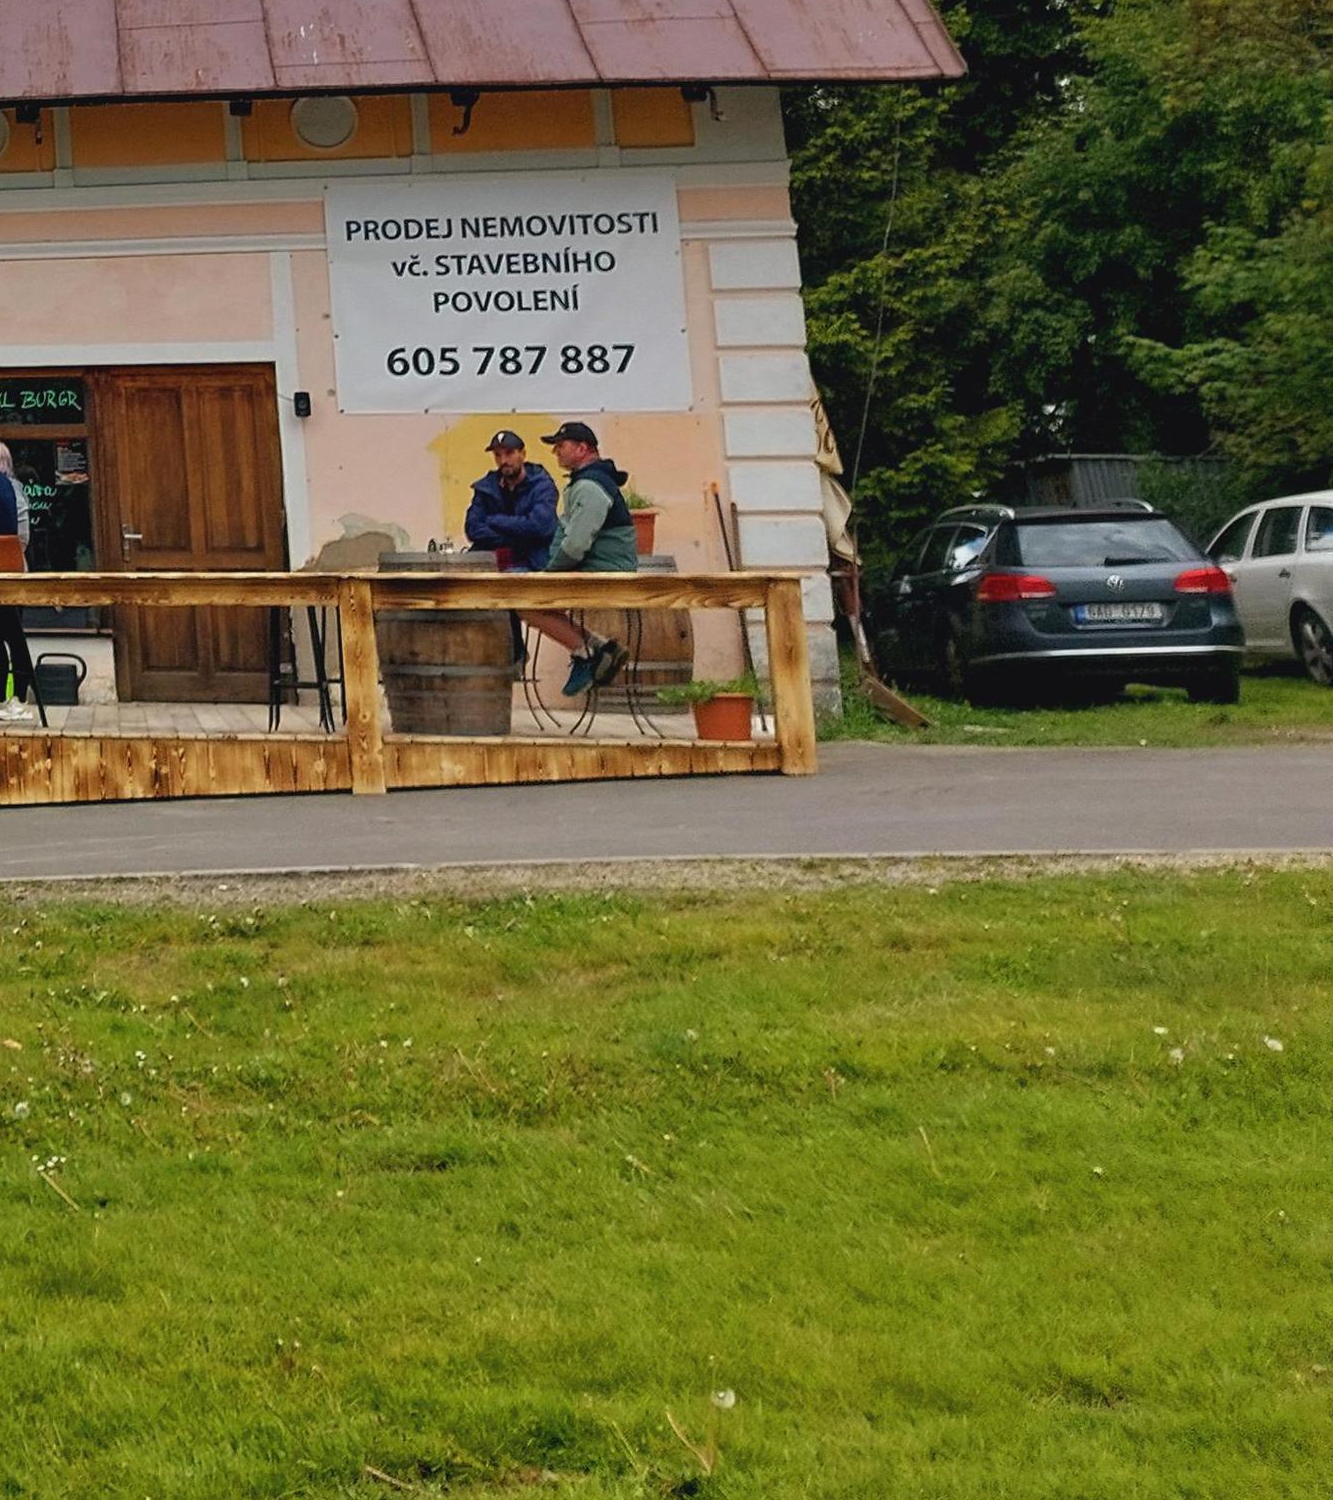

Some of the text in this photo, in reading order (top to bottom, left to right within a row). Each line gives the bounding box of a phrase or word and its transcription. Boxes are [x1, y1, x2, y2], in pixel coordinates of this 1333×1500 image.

[345, 212, 659, 242] PRODEJ NEMOVITOSTI
[390, 247, 616, 277] vč. STAVEBNÍHO
[433, 285, 580, 313] POVOLENÍ
[386, 344, 635, 376] 605 787 887
[20, 390, 82, 411] BURGR
